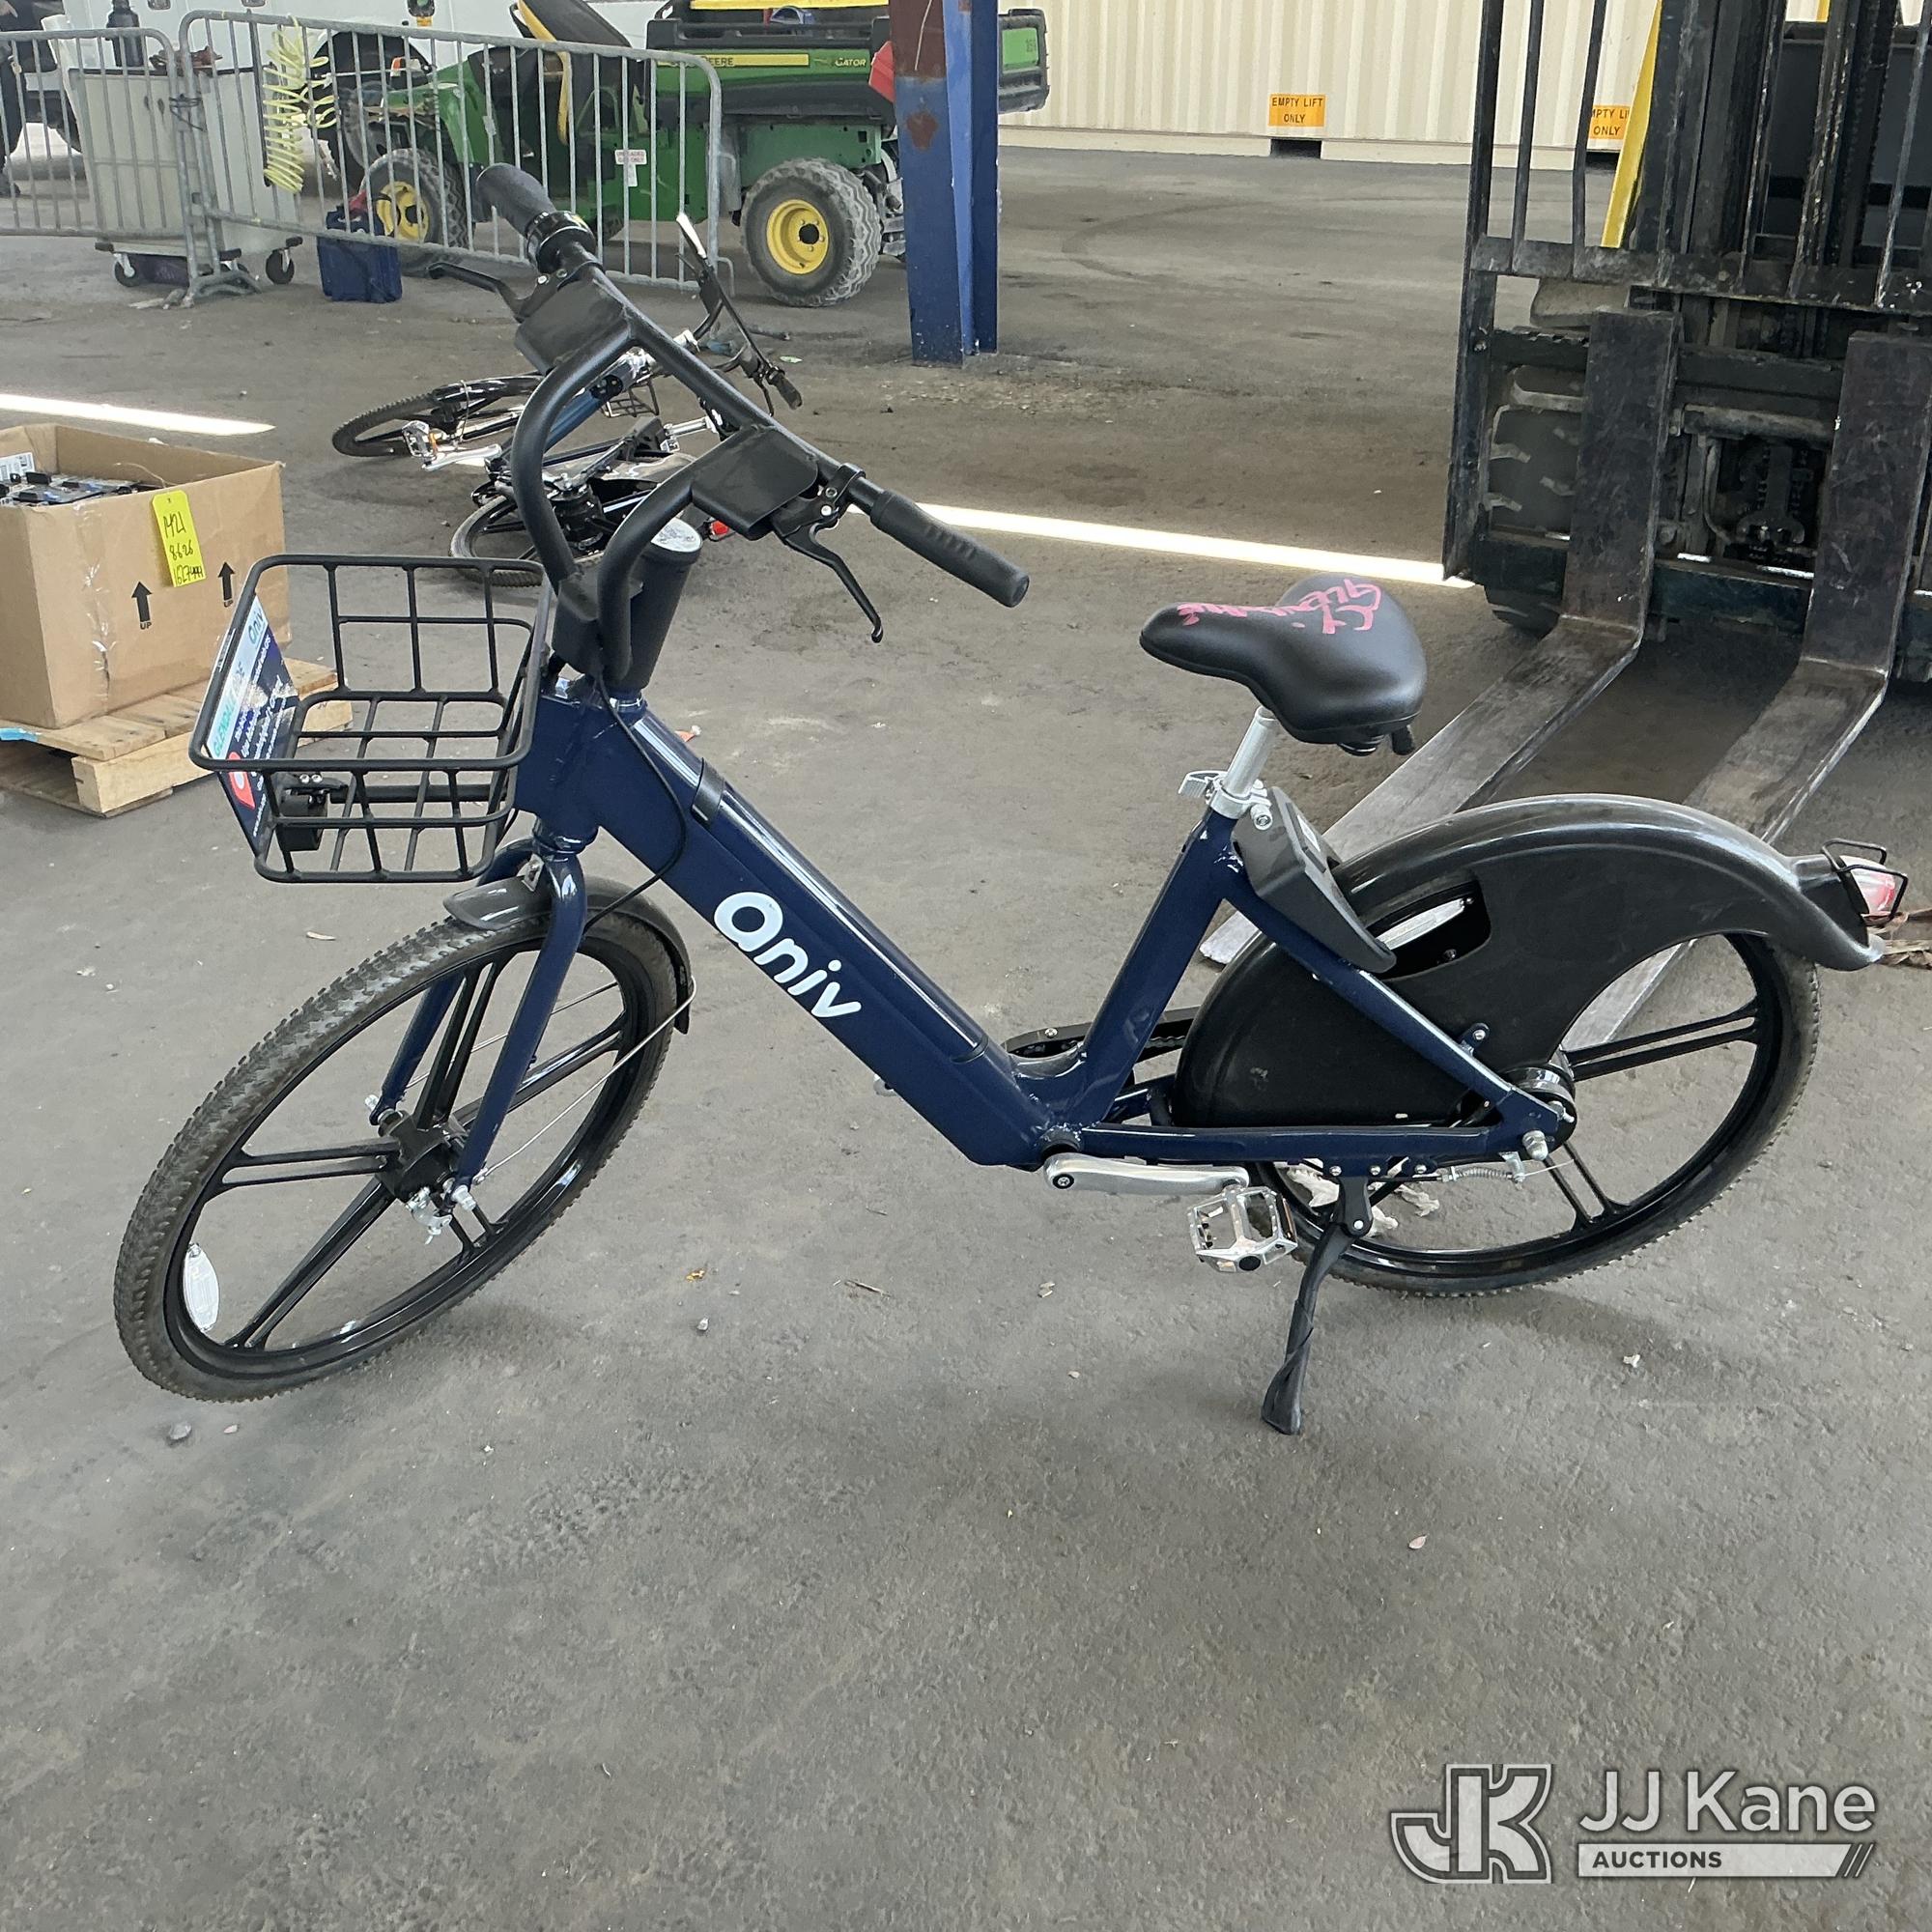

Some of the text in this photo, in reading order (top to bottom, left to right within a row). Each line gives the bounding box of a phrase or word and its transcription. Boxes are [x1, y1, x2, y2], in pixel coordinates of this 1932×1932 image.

[835, 57, 867, 67] GATOR
[1271, 97, 1323, 107] EMPTY LIFT
[1283, 113, 1306, 124] ONLY
[1593, 126, 1621, 135] ONLY
[223, 599, 234, 608] UP
[139, 621, 152, 630] UP
